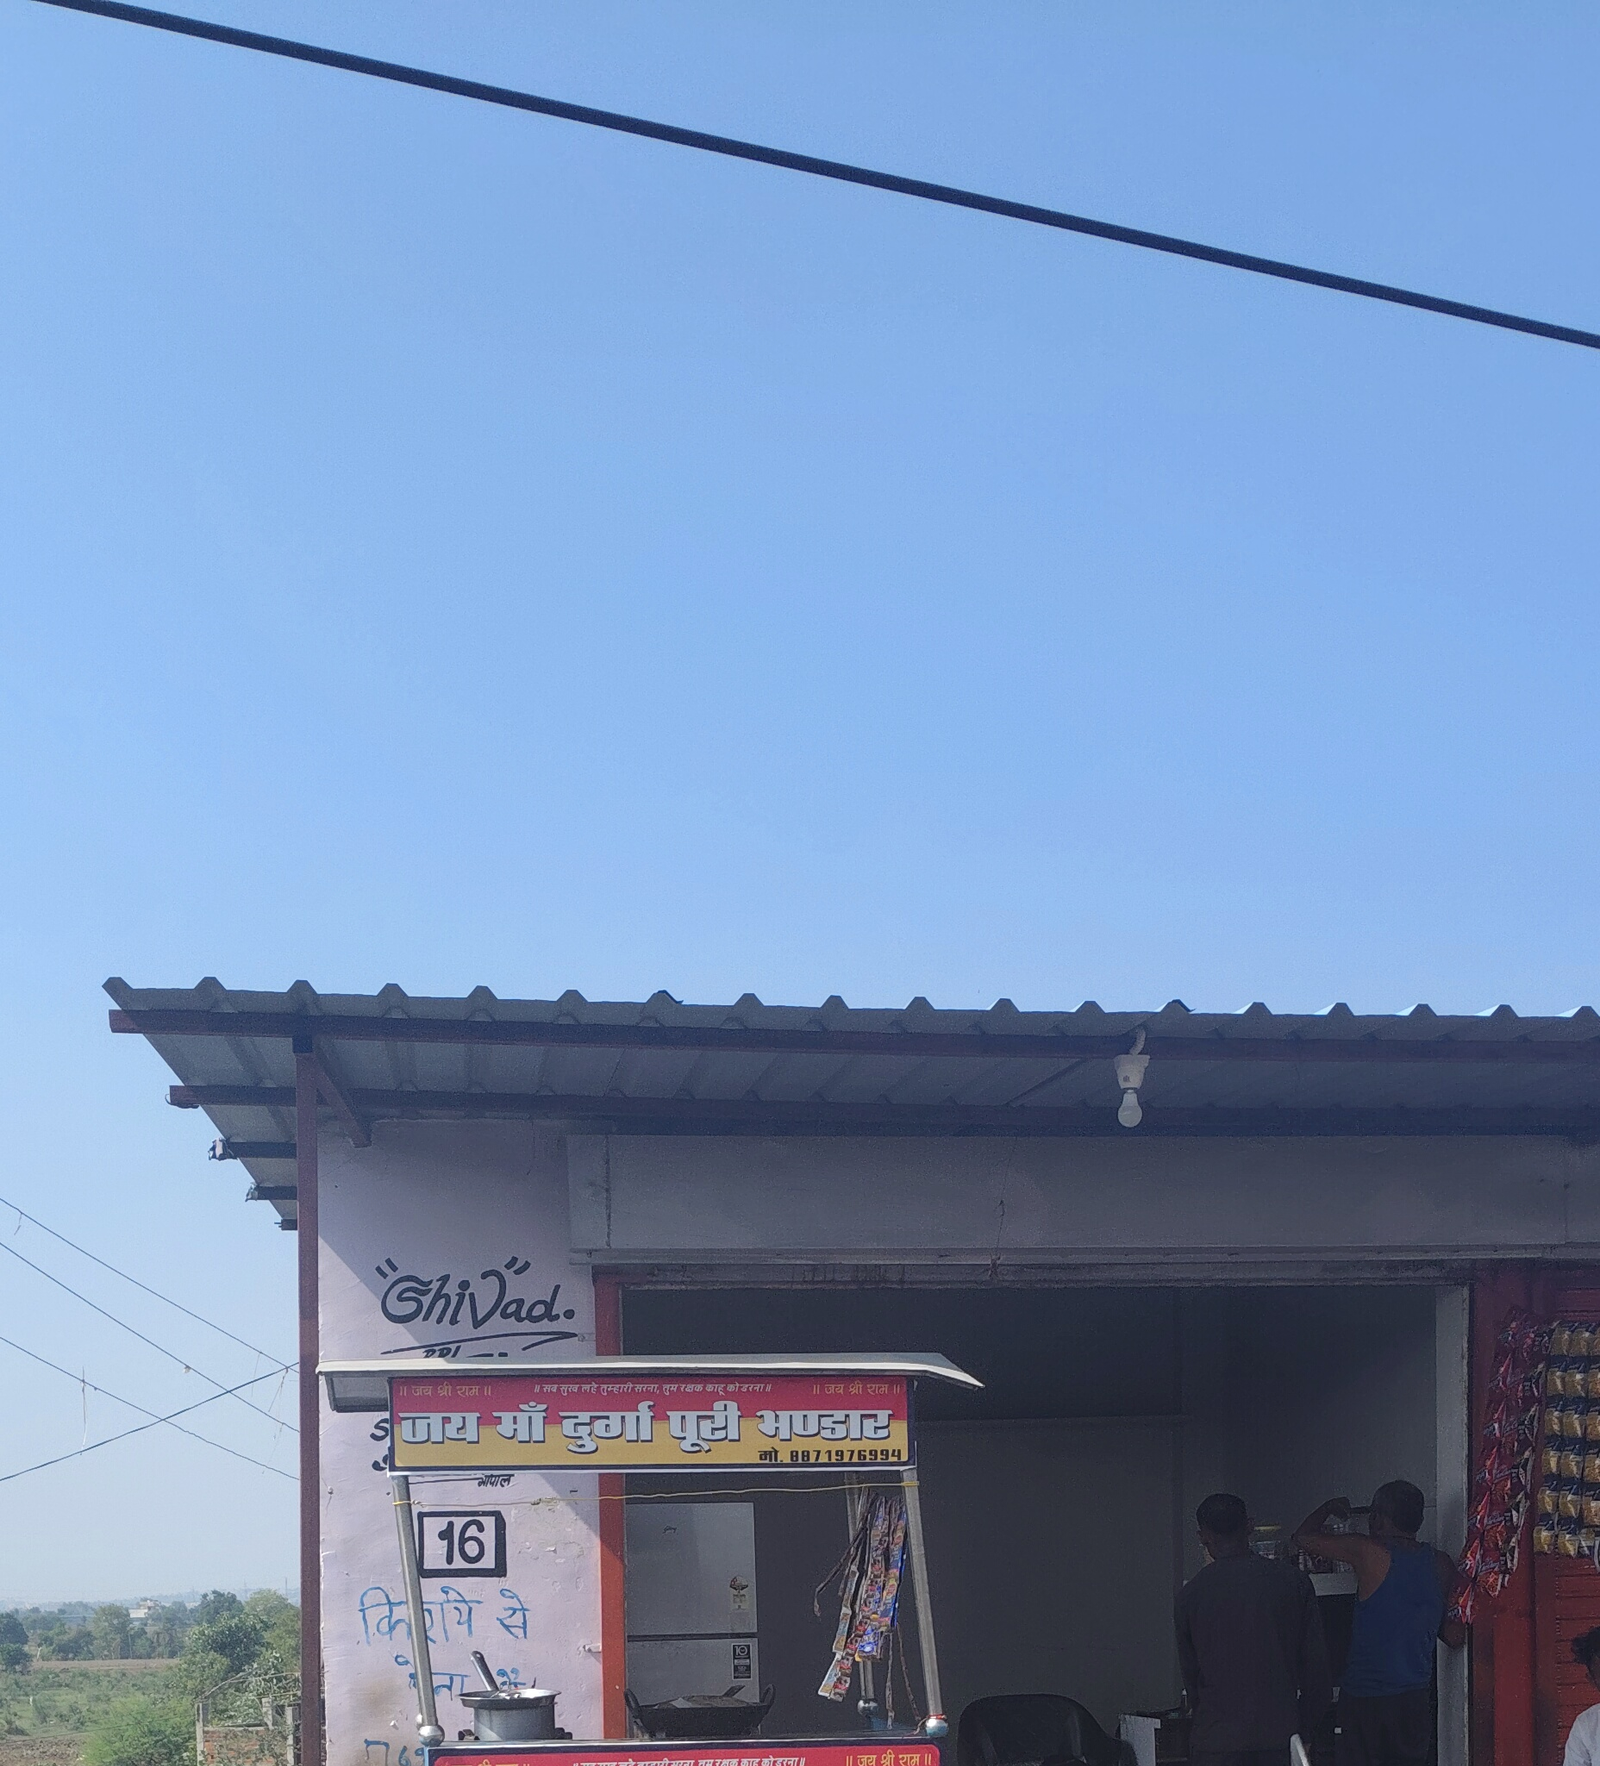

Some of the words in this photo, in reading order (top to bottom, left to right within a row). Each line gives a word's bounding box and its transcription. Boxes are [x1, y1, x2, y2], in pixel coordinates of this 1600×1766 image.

[411, 1385, 433, 1396] जय
[437, 1381, 452, 1397] श्री
[456, 1385, 480, 1397] राम
[824, 1384, 845, 1395] जय
[849, 1380, 863, 1395] श्री
[867, 1384, 889, 1395] राम
[398, 1413, 481, 1444] जय
[492, 1401, 548, 1443] माँ
[558, 1401, 656, 1454] दुर्गा
[666, 1400, 742, 1454] पूरी
[756, 1410, 893, 1441] भण्डार
[790, 1449, 902, 1462] 8871976994
[437, 1519, 486, 1566] 16
[496, 1587, 531, 1640] से
[857, 1755, 877, 1766] जय
[881, 1749, 895, 1766] श्री
[899, 1753, 921, 1766] राम
